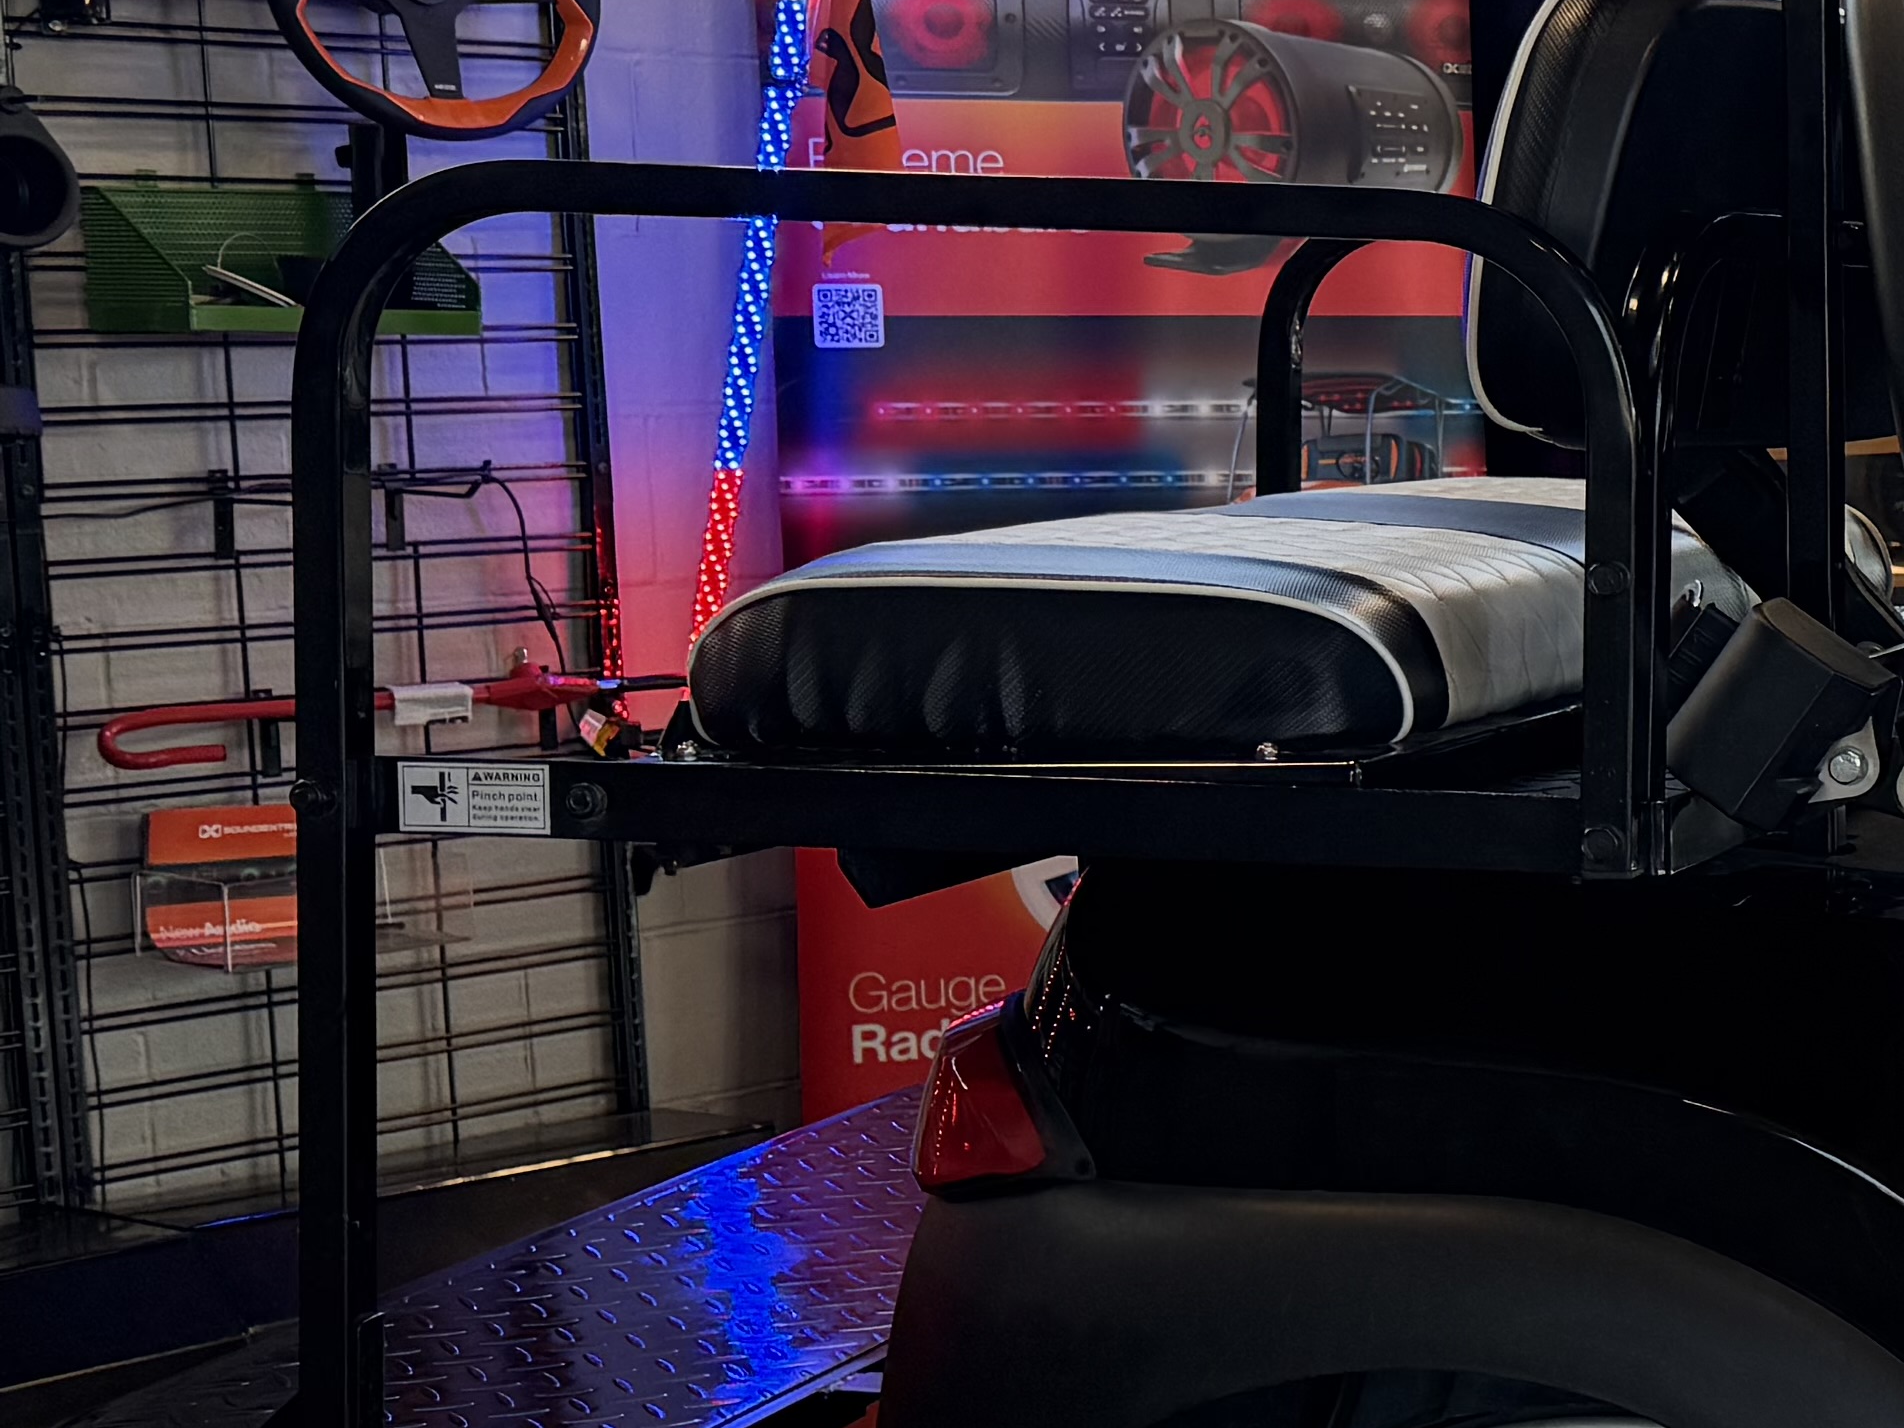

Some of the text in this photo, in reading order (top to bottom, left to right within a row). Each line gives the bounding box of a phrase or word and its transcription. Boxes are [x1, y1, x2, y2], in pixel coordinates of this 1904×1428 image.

[483, 772, 540, 783] WARNING
[472, 790, 506, 802] Pinch
[849, 972, 1006, 1015] Gauge
